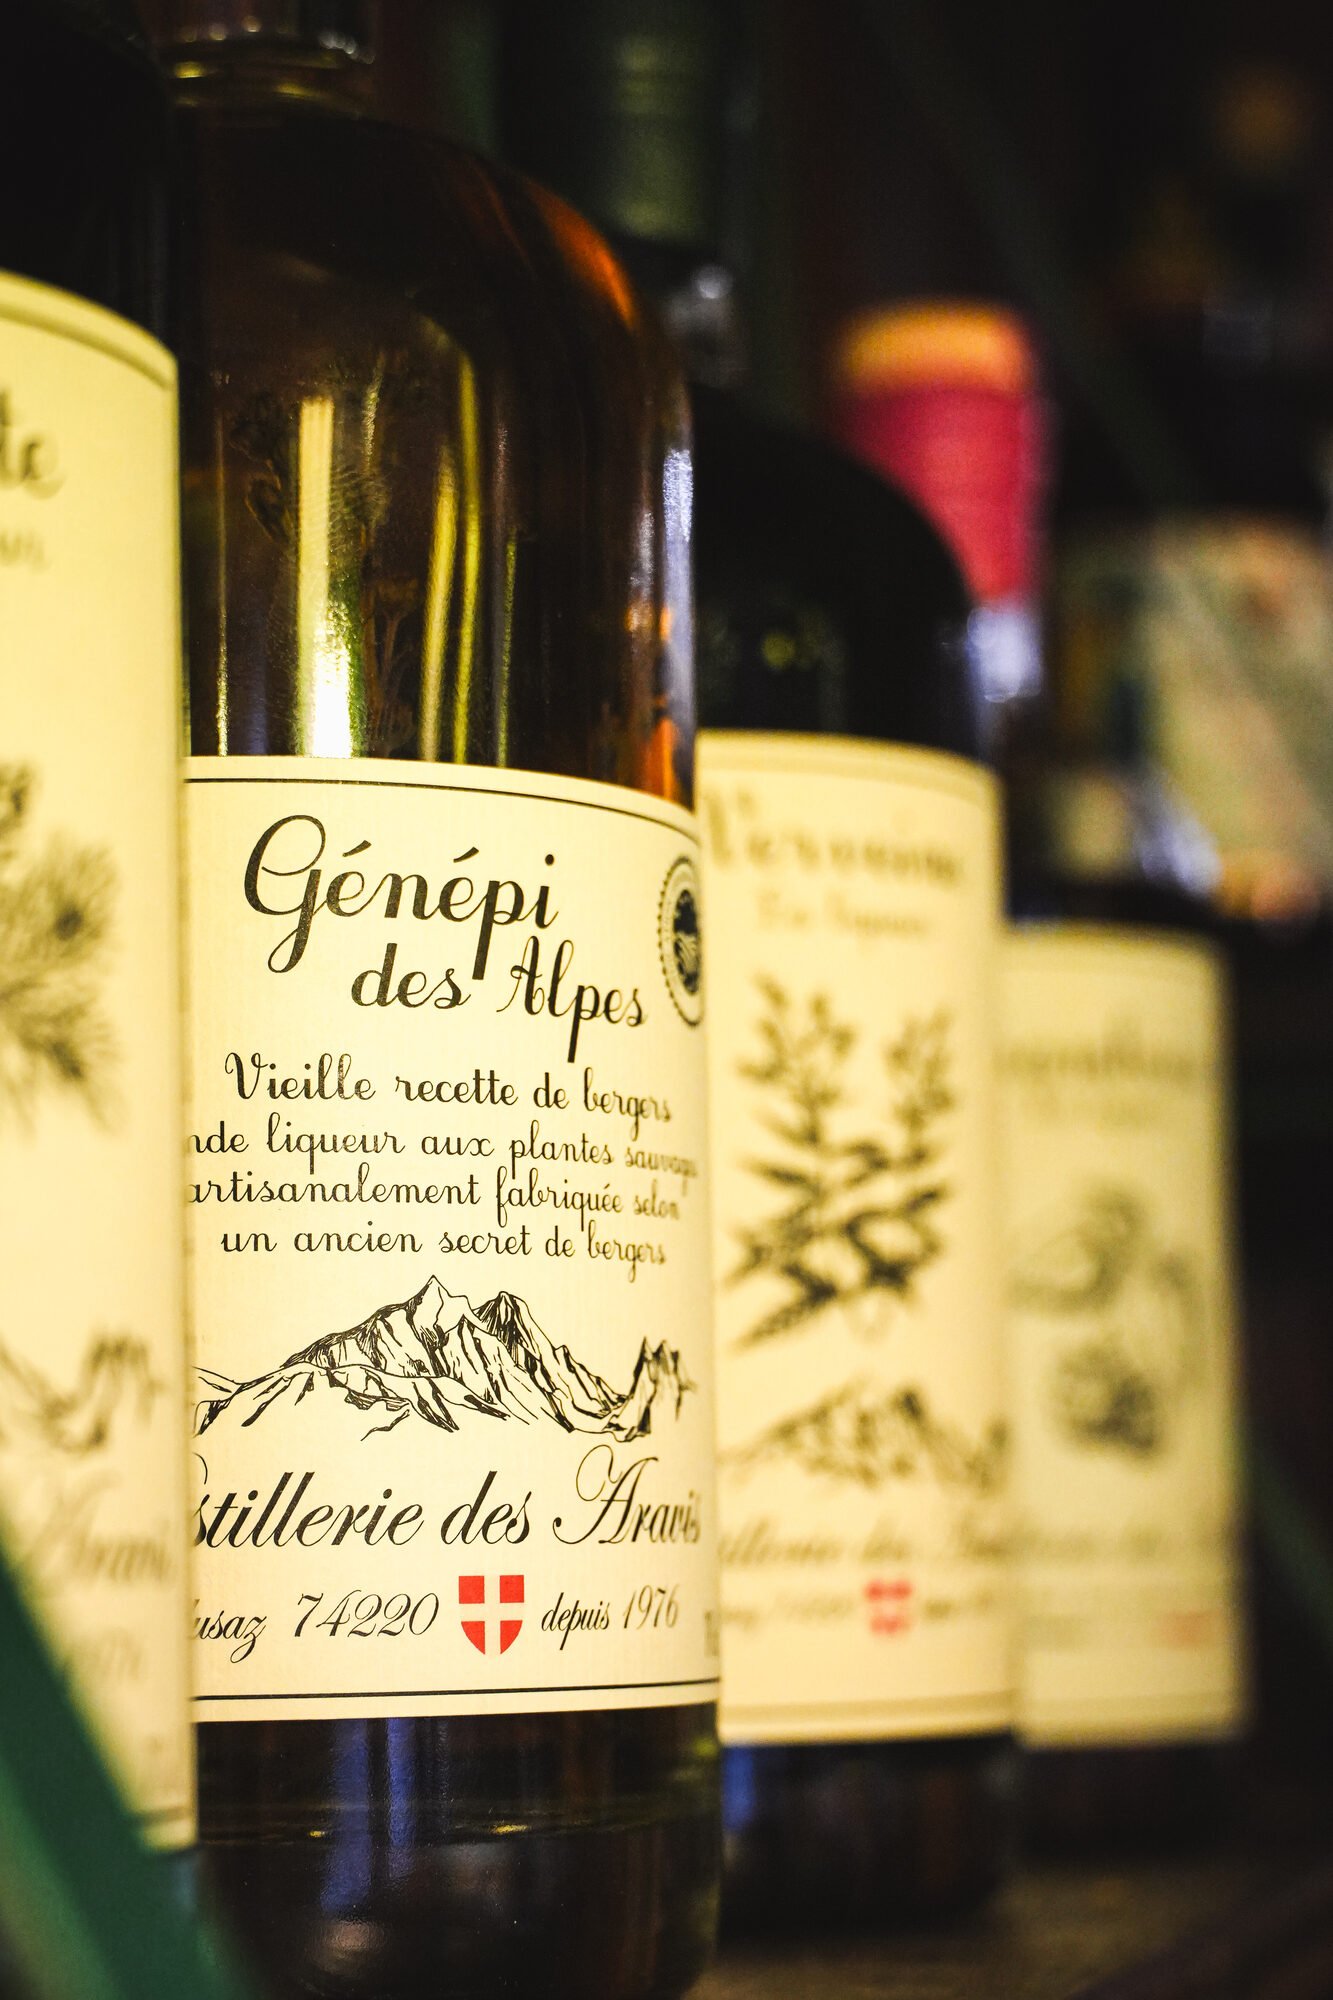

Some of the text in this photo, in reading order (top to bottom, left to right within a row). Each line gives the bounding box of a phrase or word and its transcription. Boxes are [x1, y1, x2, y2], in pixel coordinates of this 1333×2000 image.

[243, 814, 560, 980] Génépi
[350, 942, 472, 1010] des
[495, 935, 647, 1065] Alpes
[224, 1052, 673, 1143] Vieille recette de bergers
[266, 1111, 406, 1176] liqueur
[421, 1135, 496, 1158] aux
[509, 1119, 615, 1181] plantes
[187, 1161, 681, 1234] artisanalement fabriquée selon
[220, 1219, 668, 1284] un ancien secret de bergers
[189, 1451, 425, 1549] stillerie
[440, 1470, 533, 1546] des
[552, 1443, 701, 1545] Aravis
[190, 1598, 268, 1664] usaz
[293, 1589, 440, 1638] 74220
[541, 1590, 612, 1652] depuis
[622, 1584, 681, 1631] 1976
